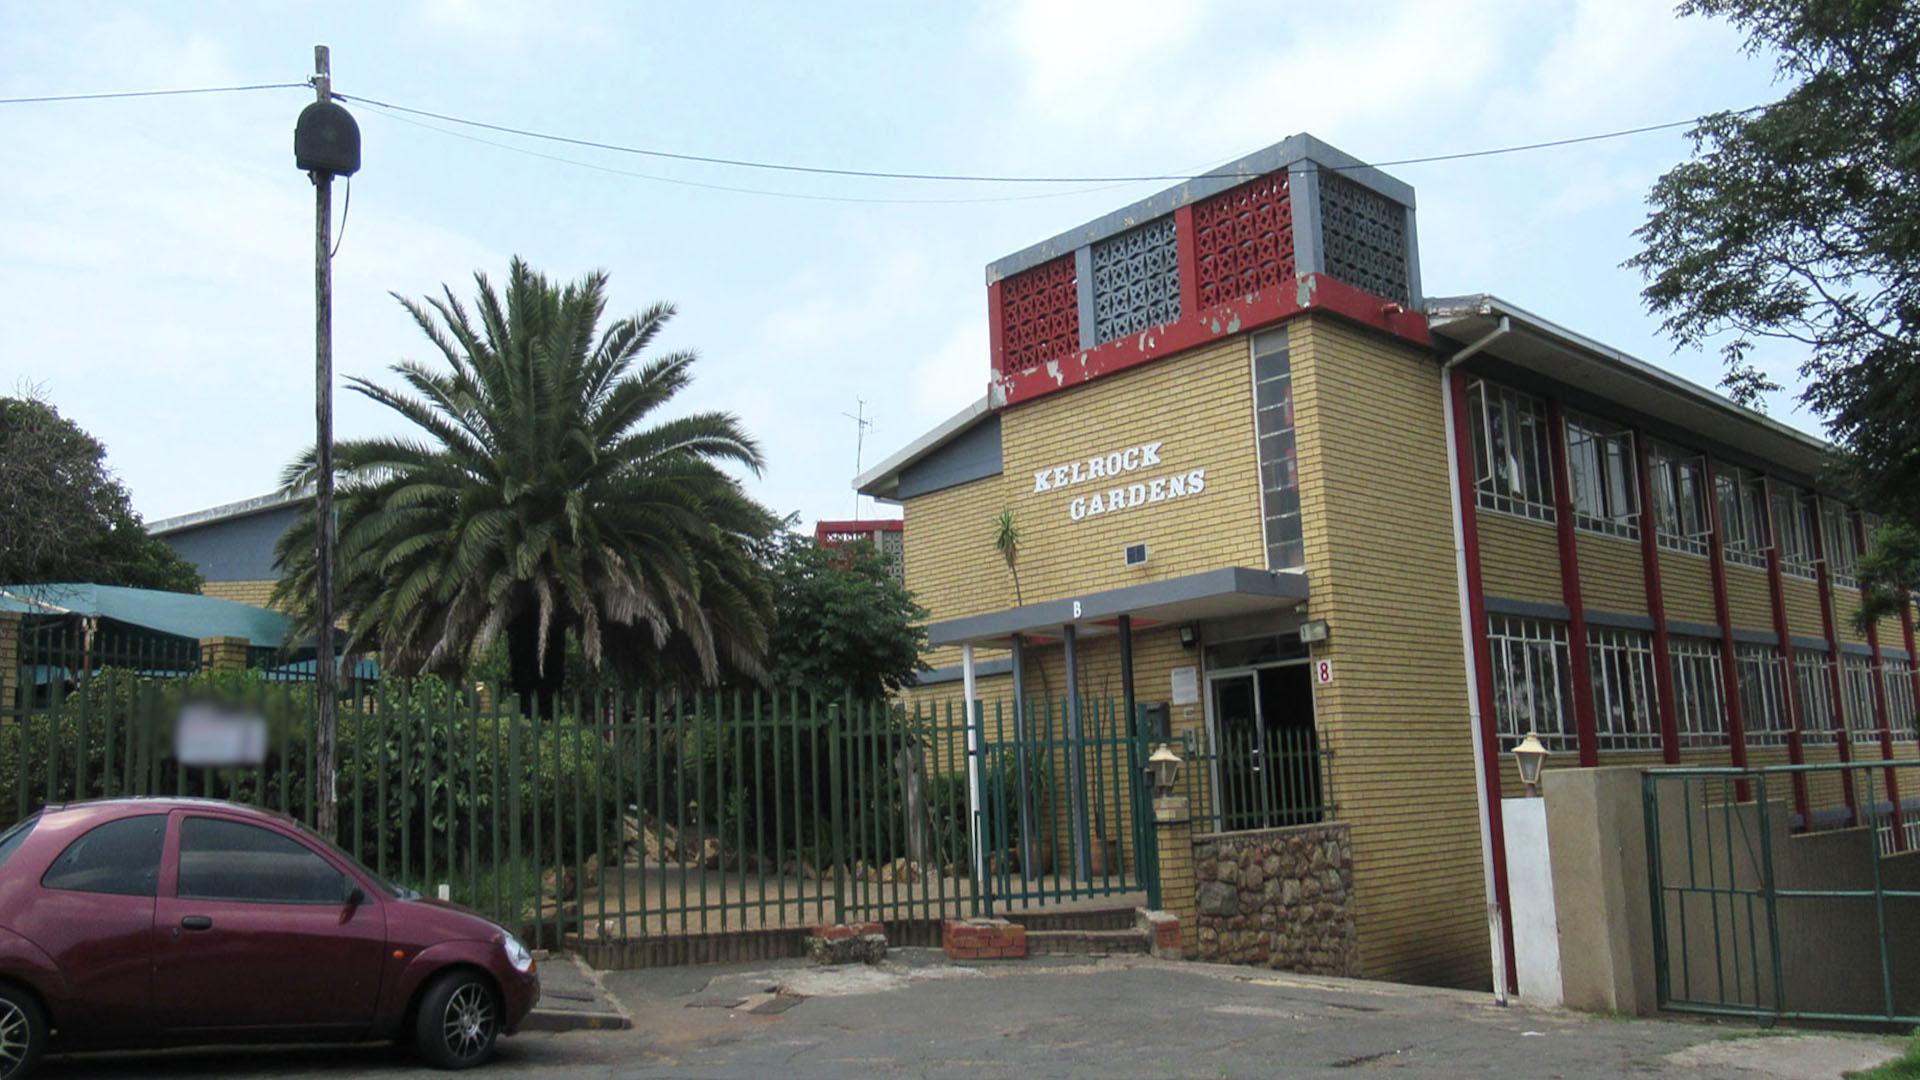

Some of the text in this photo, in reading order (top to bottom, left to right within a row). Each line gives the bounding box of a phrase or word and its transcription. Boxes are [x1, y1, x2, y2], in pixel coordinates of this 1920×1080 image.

[1033, 442, 1162, 493] KELROCK
[1070, 469, 1205, 521] GARDENS
[1073, 601, 1082, 618] B
[1320, 662, 1329, 682] 8
